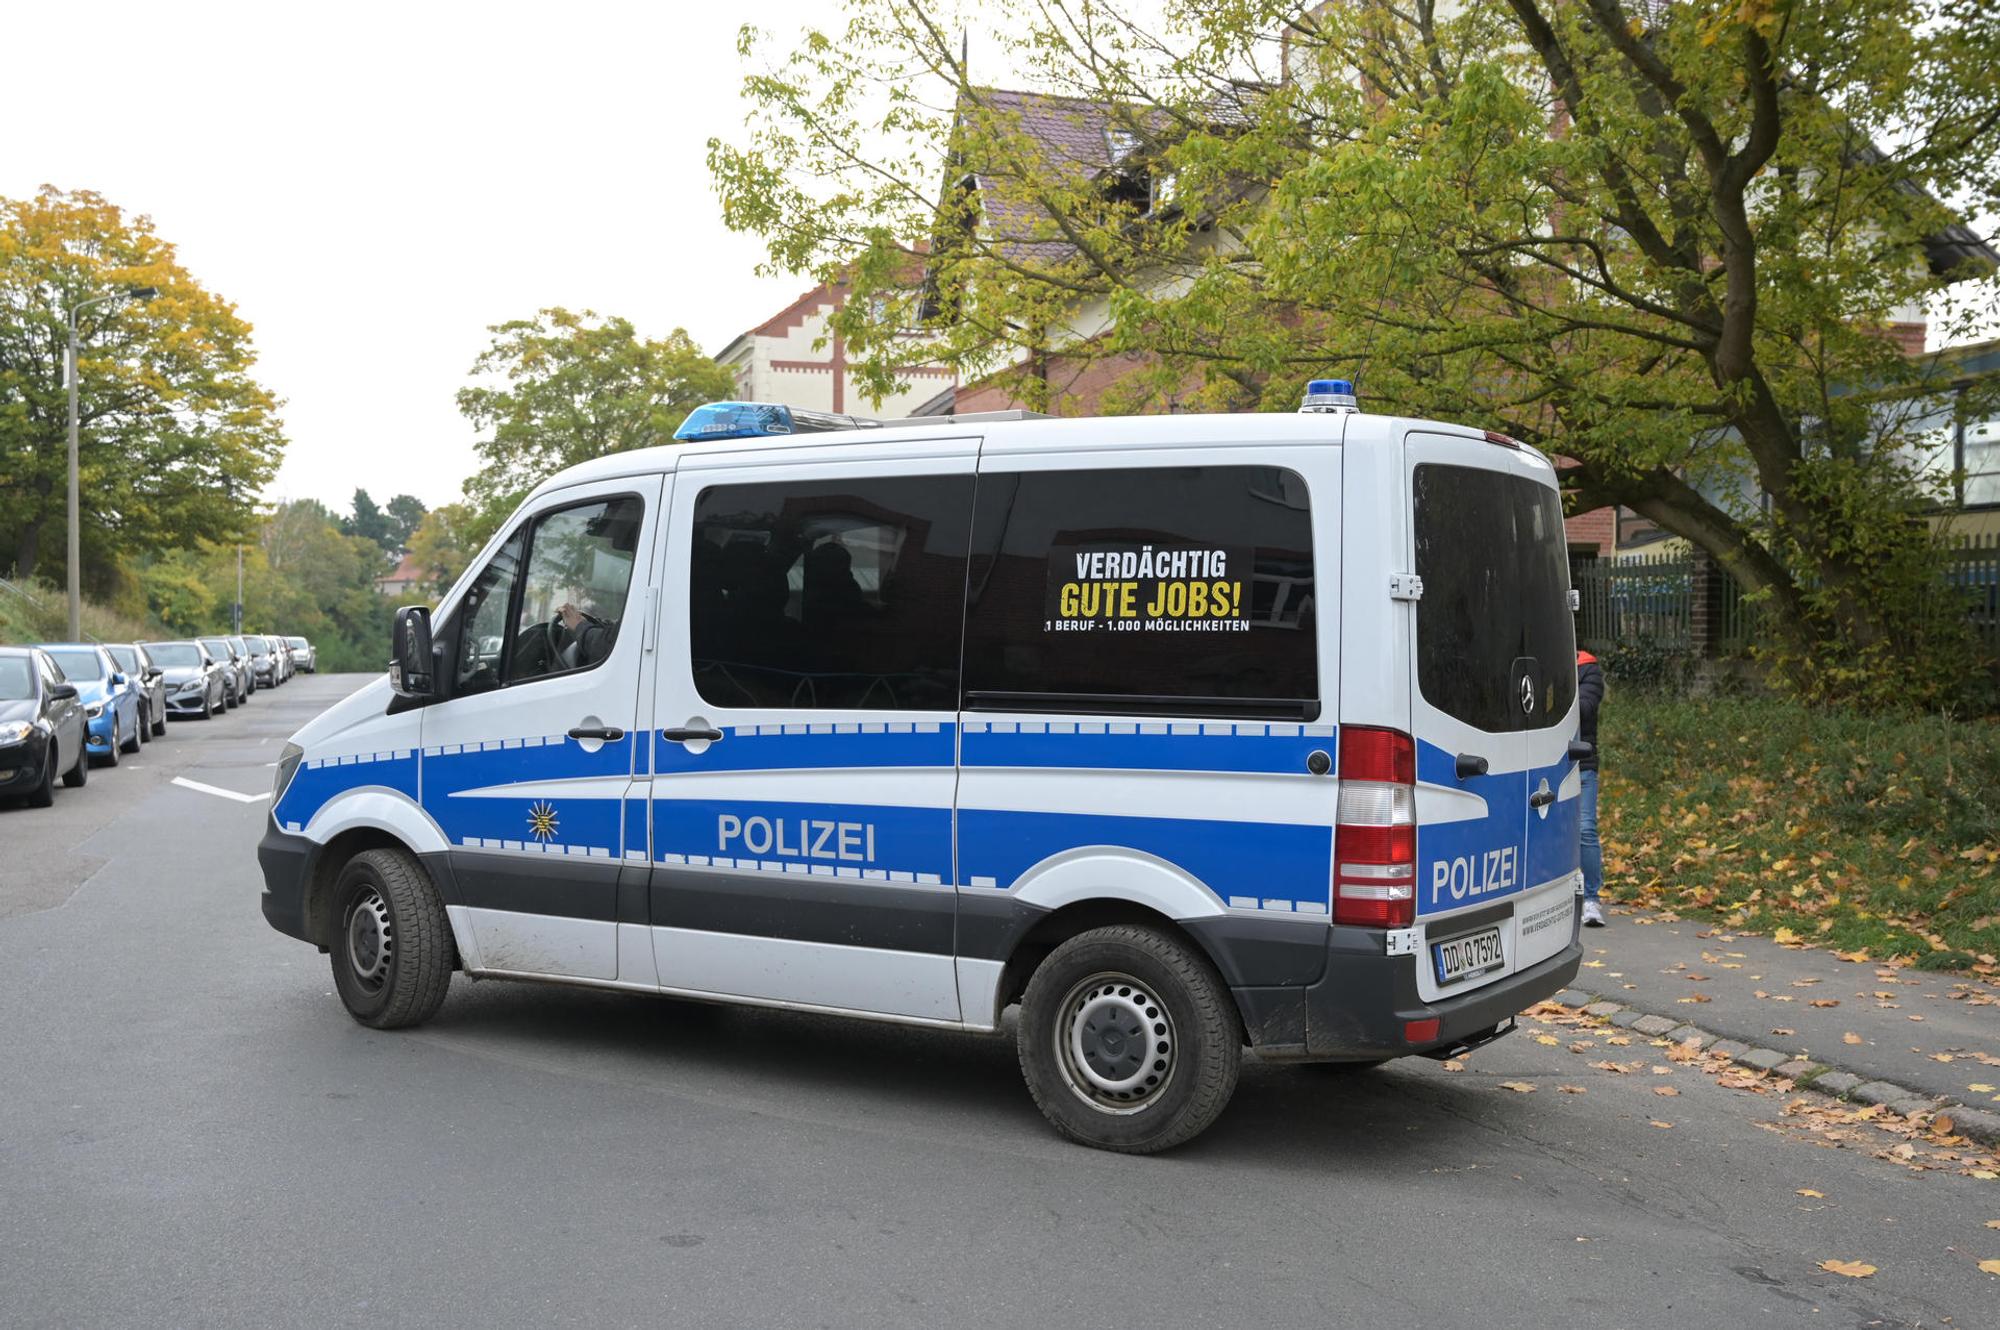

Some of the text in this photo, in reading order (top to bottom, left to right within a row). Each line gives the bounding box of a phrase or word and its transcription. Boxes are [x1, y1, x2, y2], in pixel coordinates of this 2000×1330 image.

[1076, 546, 1226, 579] VERDÄCHTIG
[1060, 581, 1241, 617] GUTE JOBS!
[1055, 620, 1095, 632] BERUF
[1108, 620, 1141, 632] 1.000
[1145, 618, 1250, 632] MÖGLICHKEITEN
[718, 814, 875, 862] POLIZEI
[1432, 845, 1518, 904] POLIZEI
[1443, 945, 1460, 974] DD
[1465, 941, 1474, 967] Q
[1473, 934, 1500, 965] 7592
